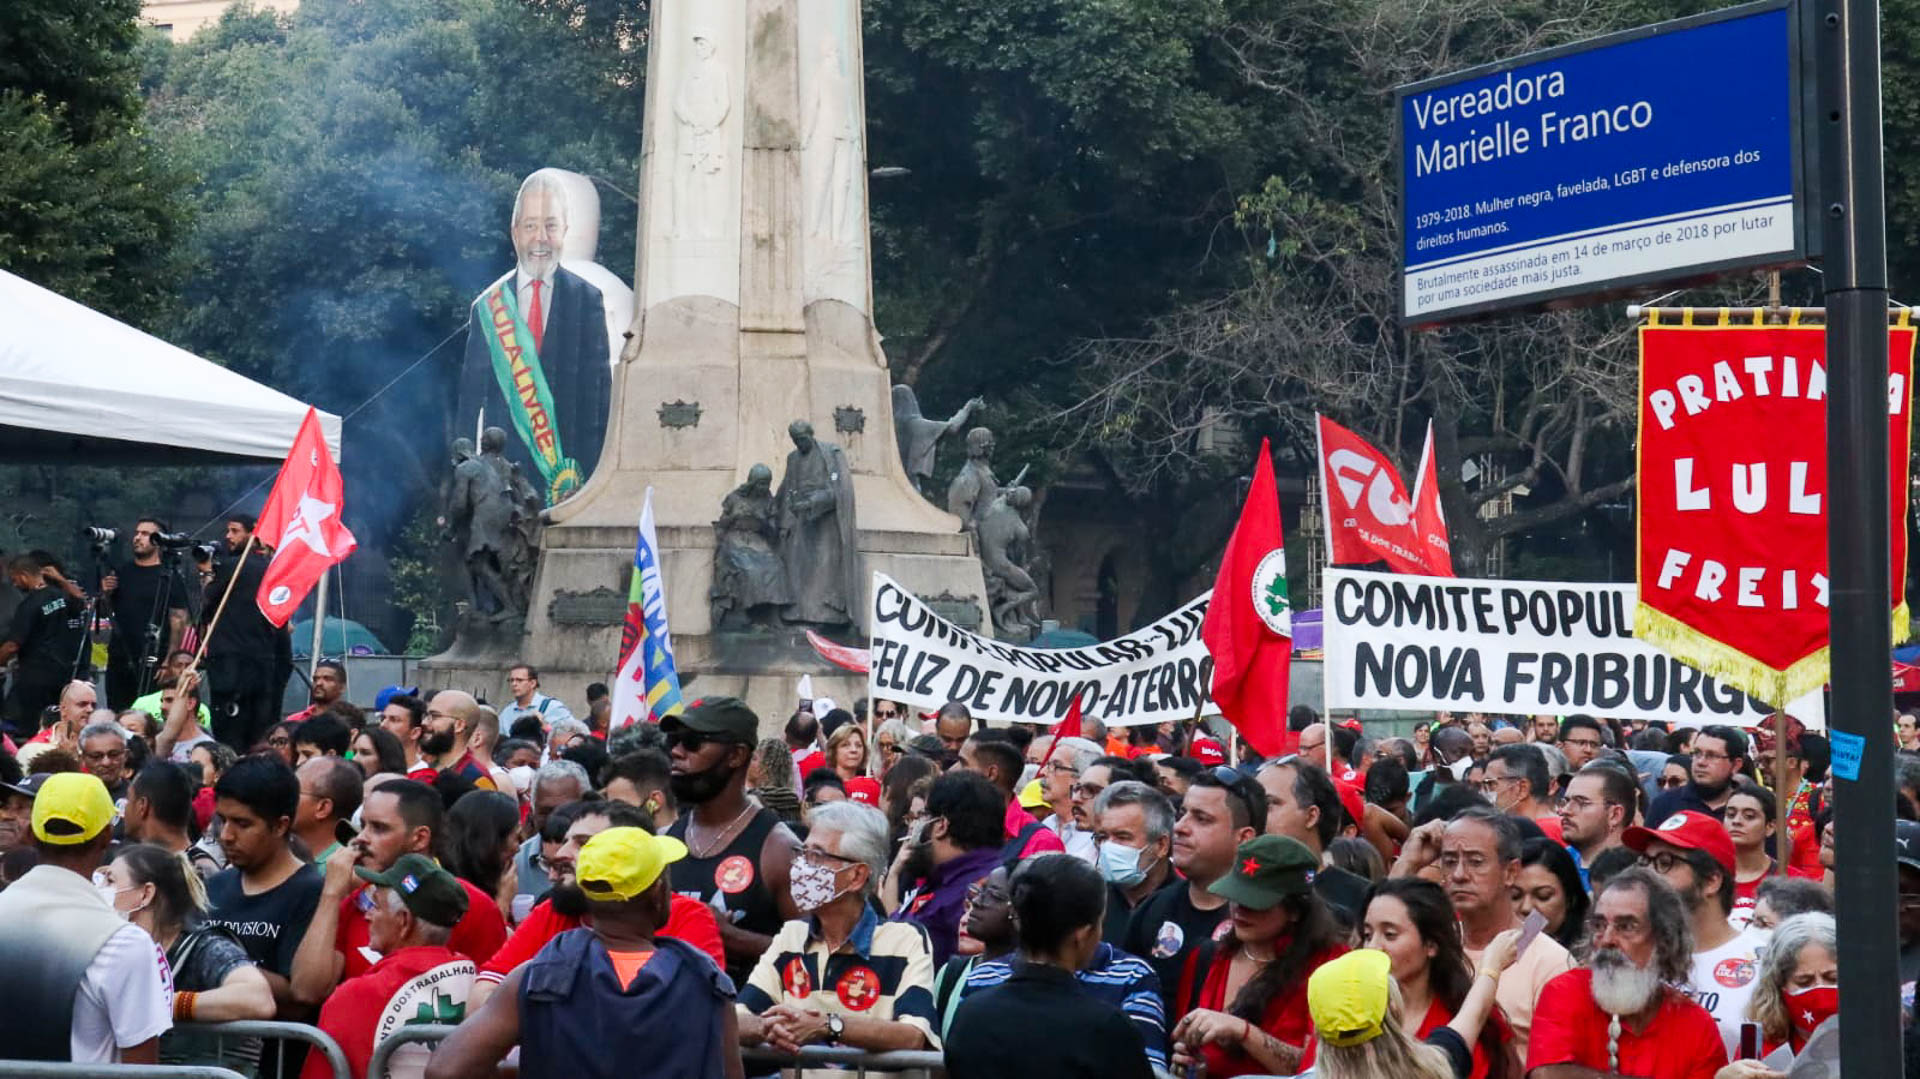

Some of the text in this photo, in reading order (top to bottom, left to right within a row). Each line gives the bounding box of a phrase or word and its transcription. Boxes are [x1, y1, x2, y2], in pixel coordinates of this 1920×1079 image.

[1413, 71, 1565, 130] Vereadora
[1416, 101, 1653, 178] Marielle Franco
[1475, 197, 1514, 216] Mulher
[1518, 190, 1554, 207] negra,
[1557, 176, 1611, 200] favelada,
[1614, 167, 1648, 187] LGBT
[1651, 169, 1660, 180] e
[1662, 155, 1731, 178] defensora
[1734, 149, 1761, 165] dos
[1416, 221, 1510, 251] direitos humanos.
[1417, 215, 1774, 291] Brutalmente assassinada em 14 de março de 2018 por lutar
[1417, 294, 1435, 309] por
[1438, 287, 1460, 302] uma
[1463, 275, 1519, 295] sociedade
[1522, 270, 1550, 285] mais
[488, 289, 556, 453] LULA LIVRE
[1335, 578, 1499, 633] COMITE
[946, 664, 1004, 710] DE
[1355, 641, 1486, 700] NOVA
